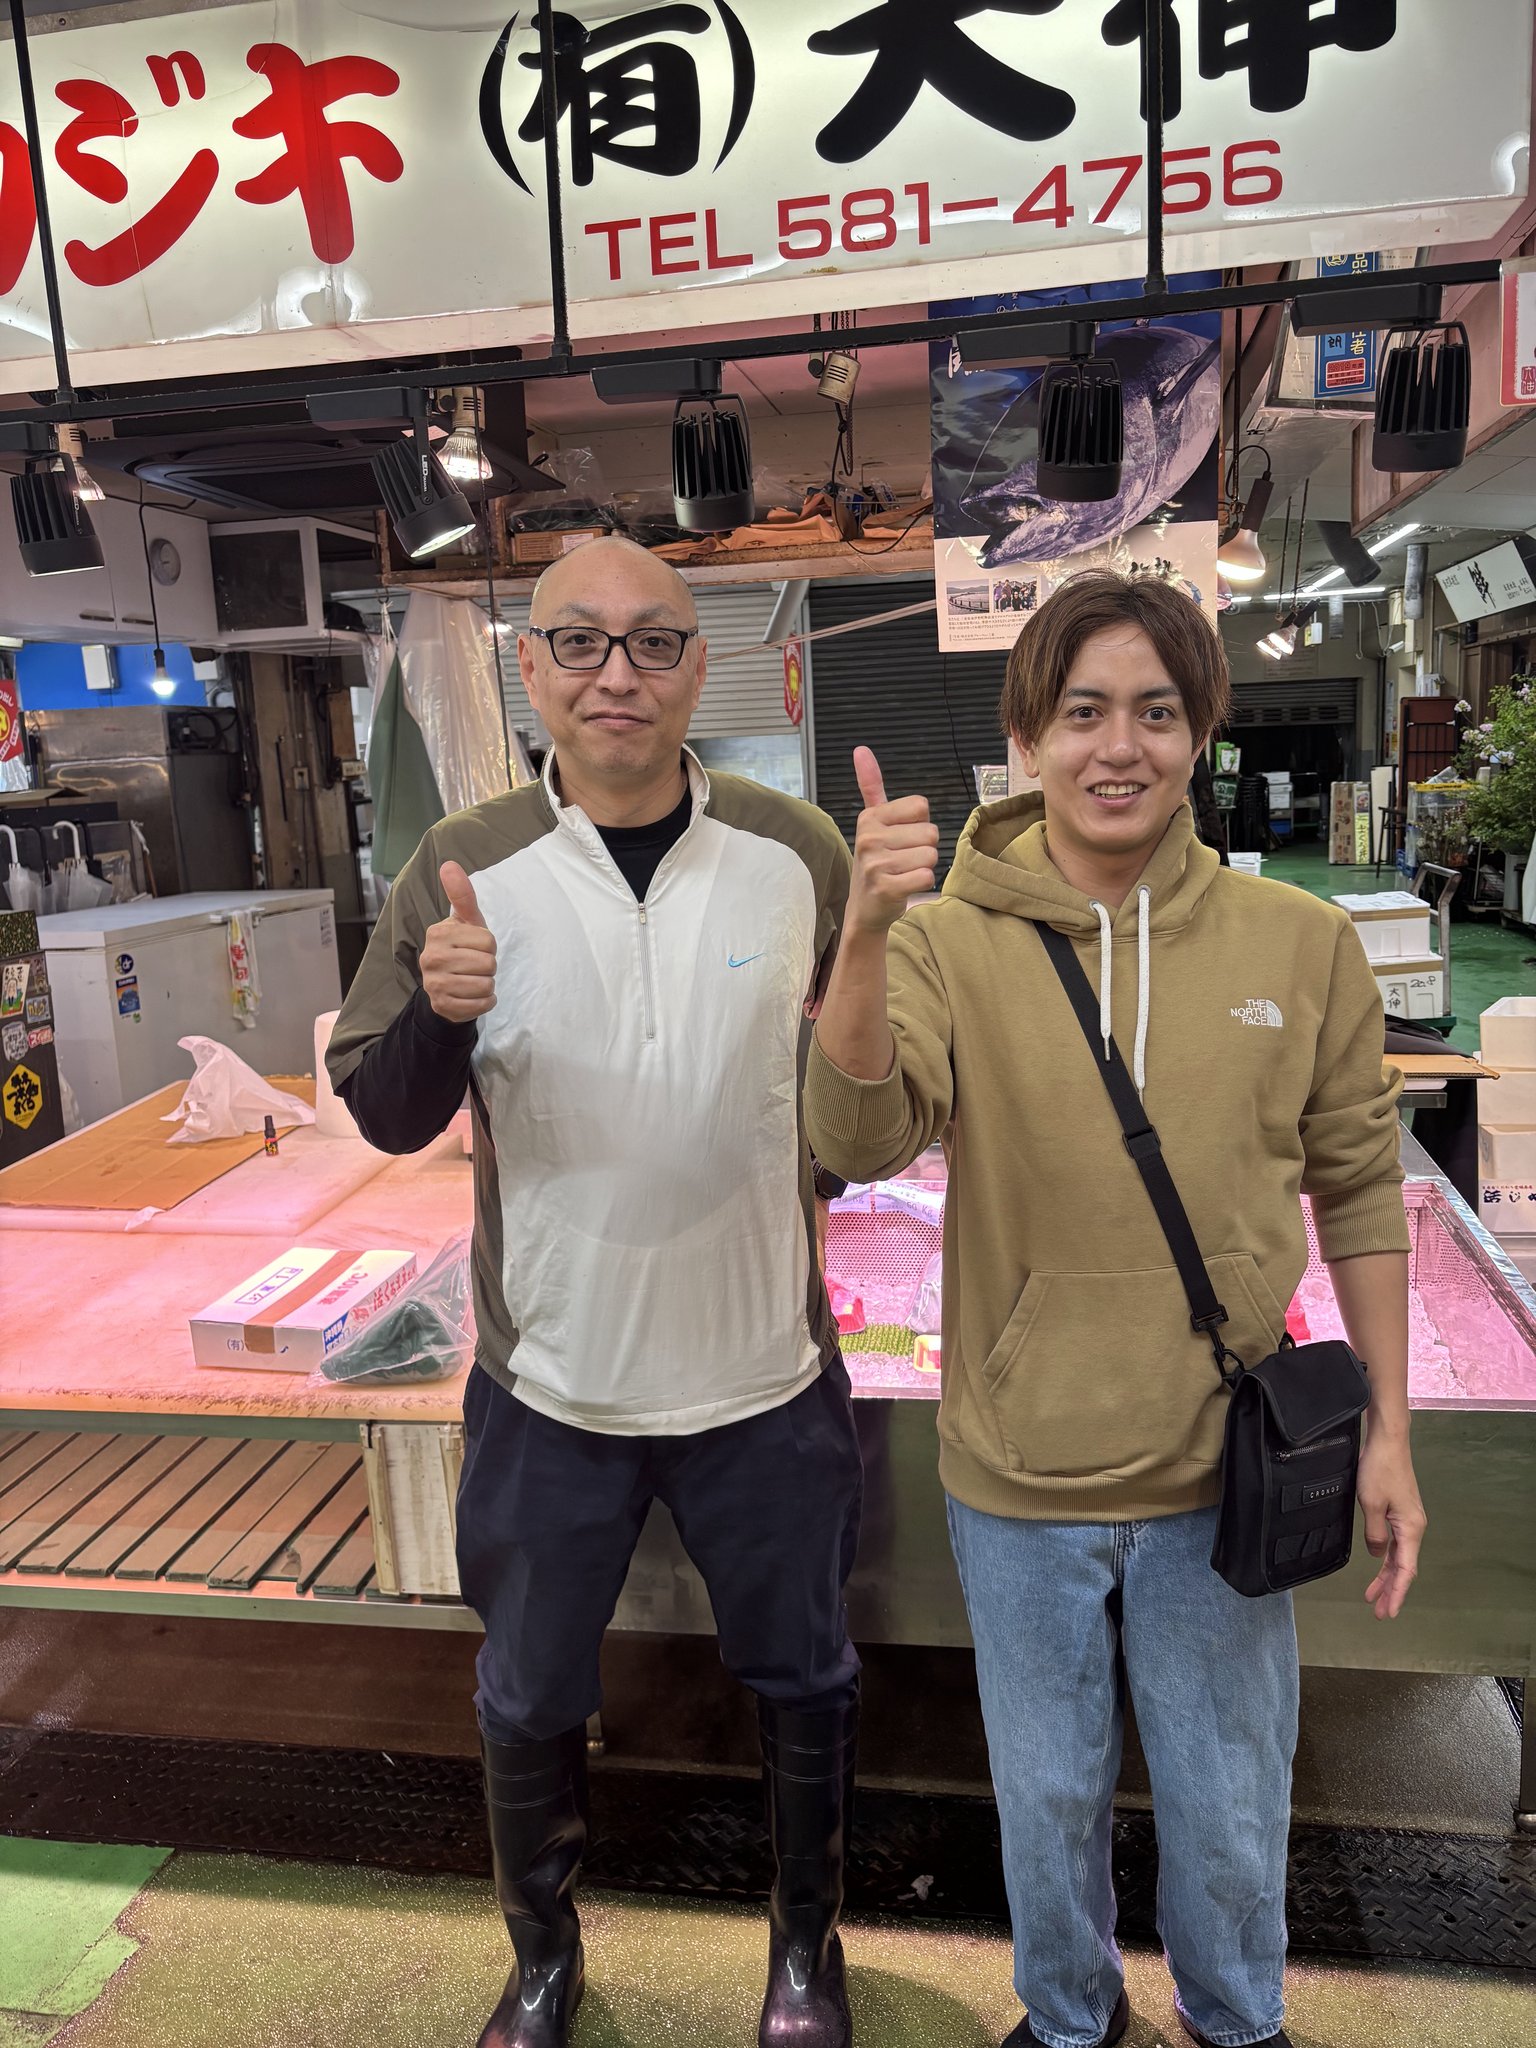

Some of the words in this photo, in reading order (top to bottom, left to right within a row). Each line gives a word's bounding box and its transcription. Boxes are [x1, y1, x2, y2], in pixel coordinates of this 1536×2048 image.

[585, 208, 753, 281] TEL
[777, 140, 1284, 261] 581-4756
[1245, 999, 1266, 1008] THE
[1230, 1008, 1267, 1017] NORTH
[1242, 1016, 1267, 1026] FACE
[1309, 1485, 1340, 1499] CRONOS
